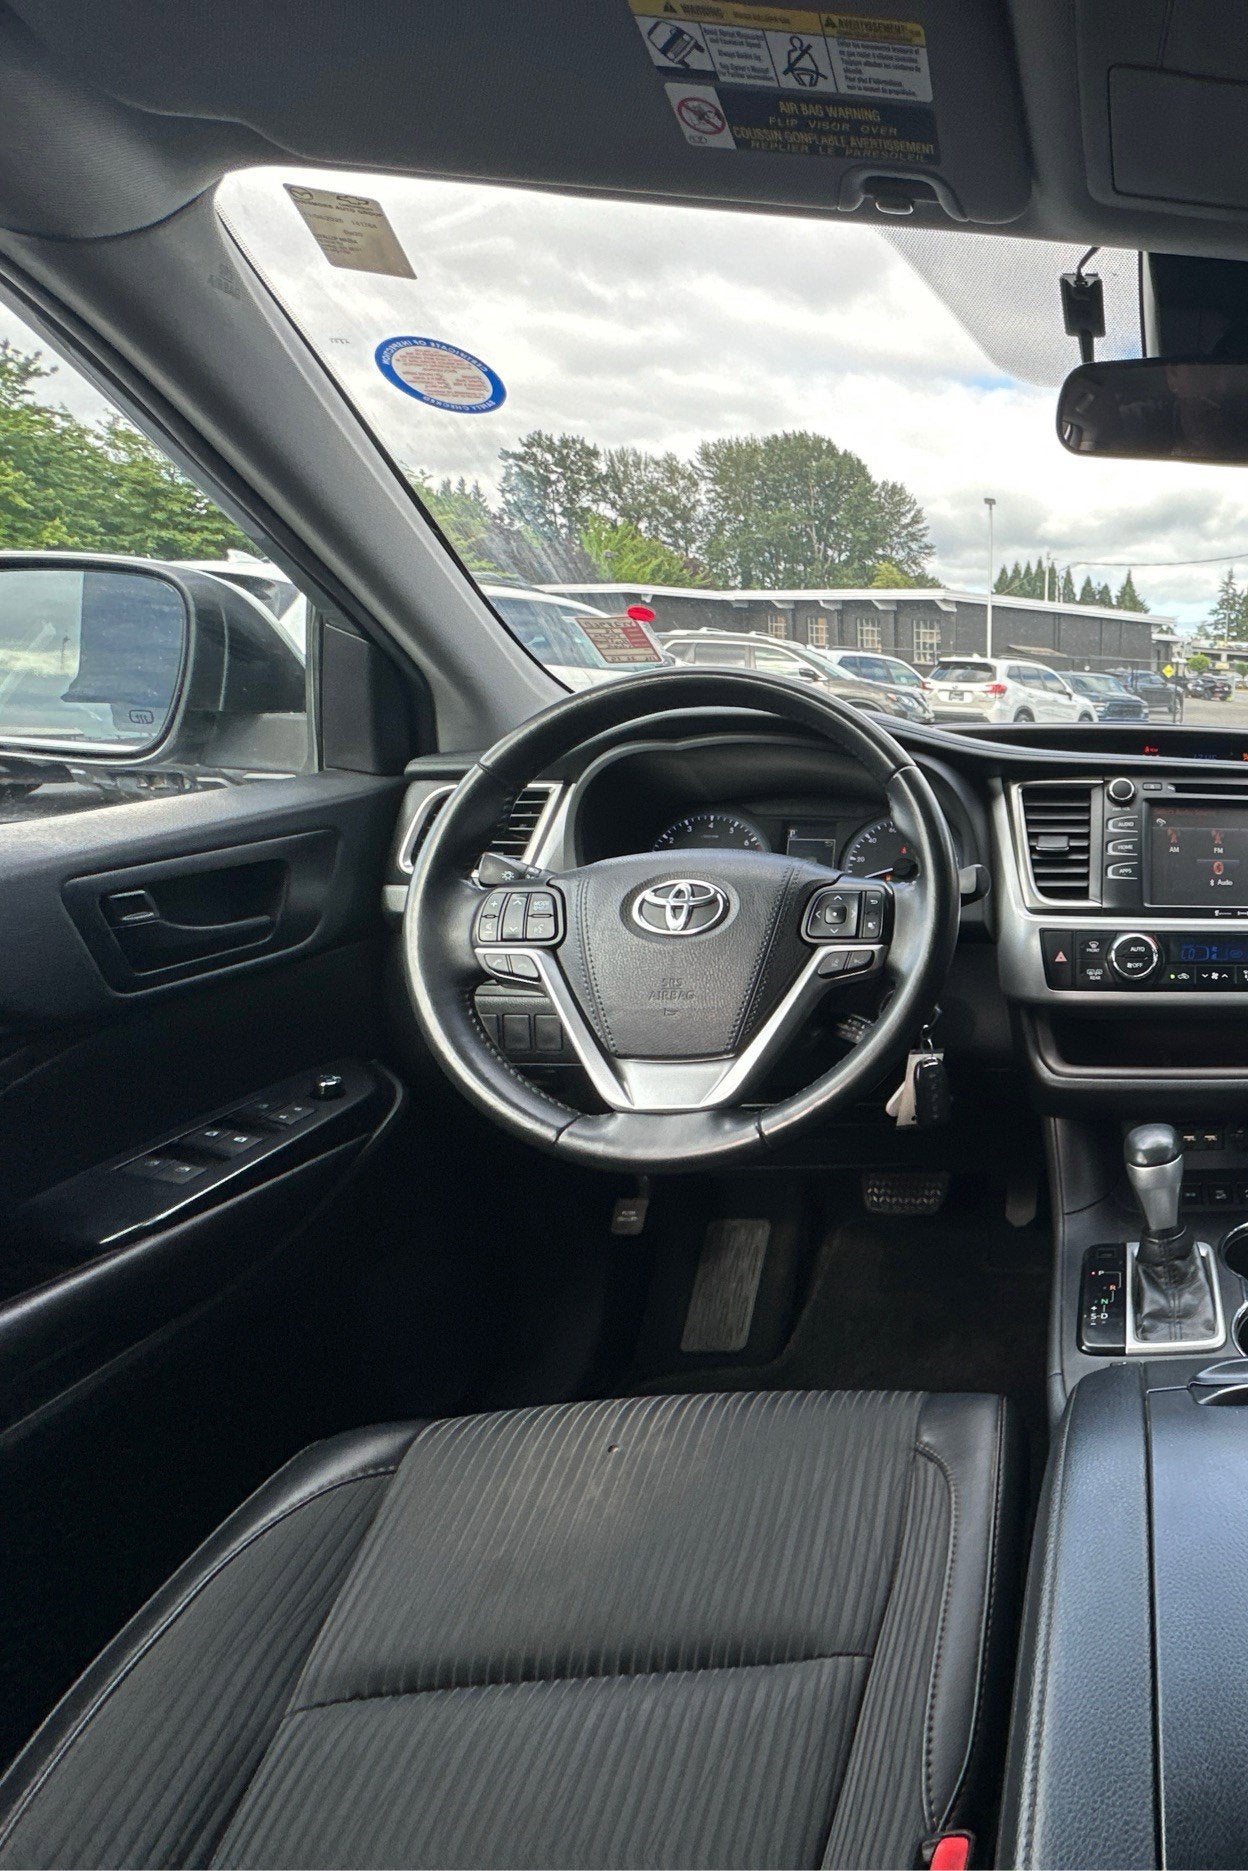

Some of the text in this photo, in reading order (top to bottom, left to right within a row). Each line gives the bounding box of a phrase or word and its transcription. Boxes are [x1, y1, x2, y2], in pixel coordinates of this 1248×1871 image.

[778, 101, 881, 122] AIR BAG WARNING
[732, 126, 782, 141] COUSSIN
[768, 116, 898, 135] FLIP VISOR OVER
[648, 990, 695, 1000] AIRBAG
